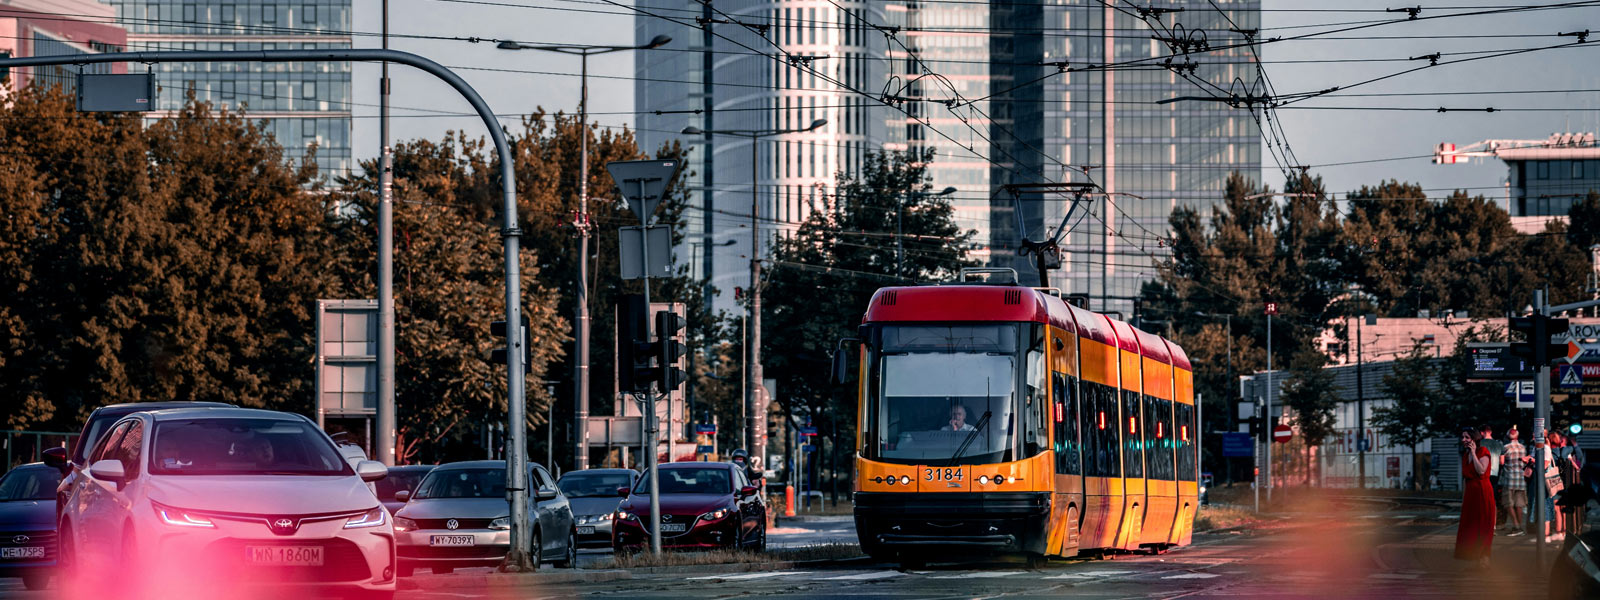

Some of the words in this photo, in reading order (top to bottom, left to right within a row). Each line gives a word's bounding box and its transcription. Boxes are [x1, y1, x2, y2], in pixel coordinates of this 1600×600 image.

[924, 468, 963, 481] 3184
[435, 536, 446, 545] WY
[447, 536, 472, 545] 7039X
[3, 548, 16, 557] WE
[255, 548, 273, 562] WN
[279, 548, 320, 562] 1860M
